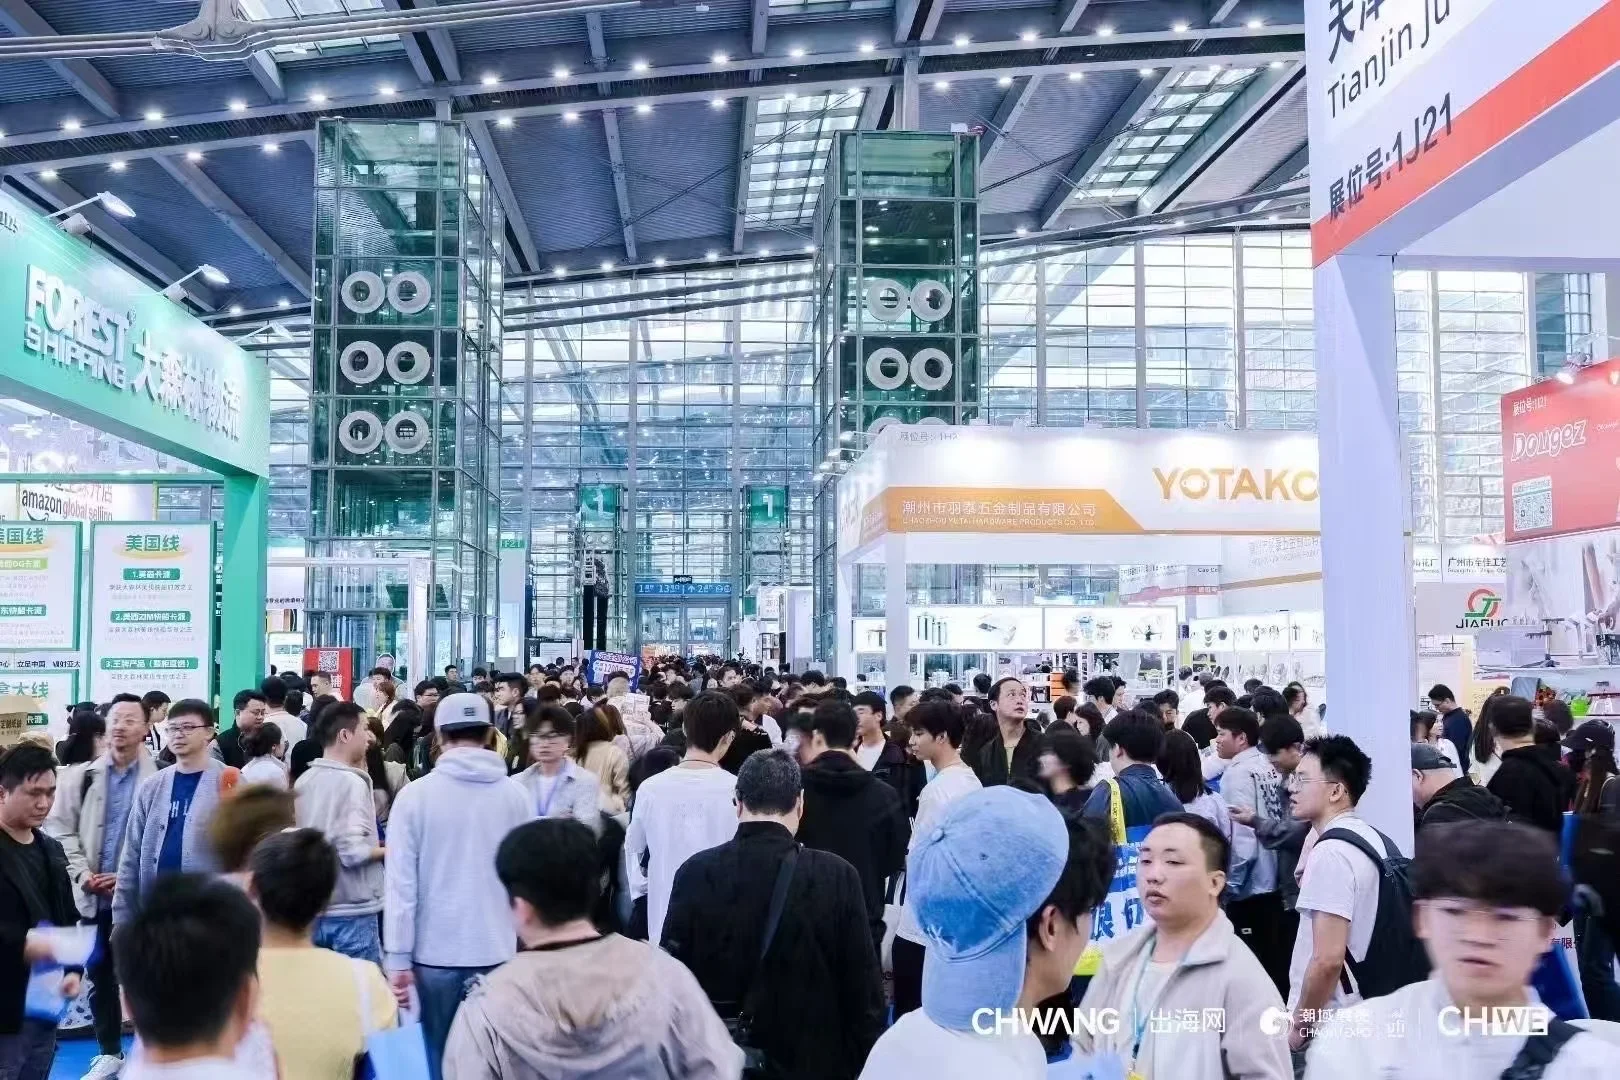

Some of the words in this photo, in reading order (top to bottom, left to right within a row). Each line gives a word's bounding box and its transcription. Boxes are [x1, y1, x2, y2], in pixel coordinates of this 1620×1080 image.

[1327, 21, 1413, 119] Tianjin
[26, 263, 131, 362] FOREST
[21, 489, 62, 515] amazon
[62, 497, 87, 520] global
[763, 494, 773, 518] 1
[902, 501, 1097, 516] 潮州市羽泰五金制品有限公司
[0, 528, 43, 545] 国线
[125, 534, 180, 552] 美国线
